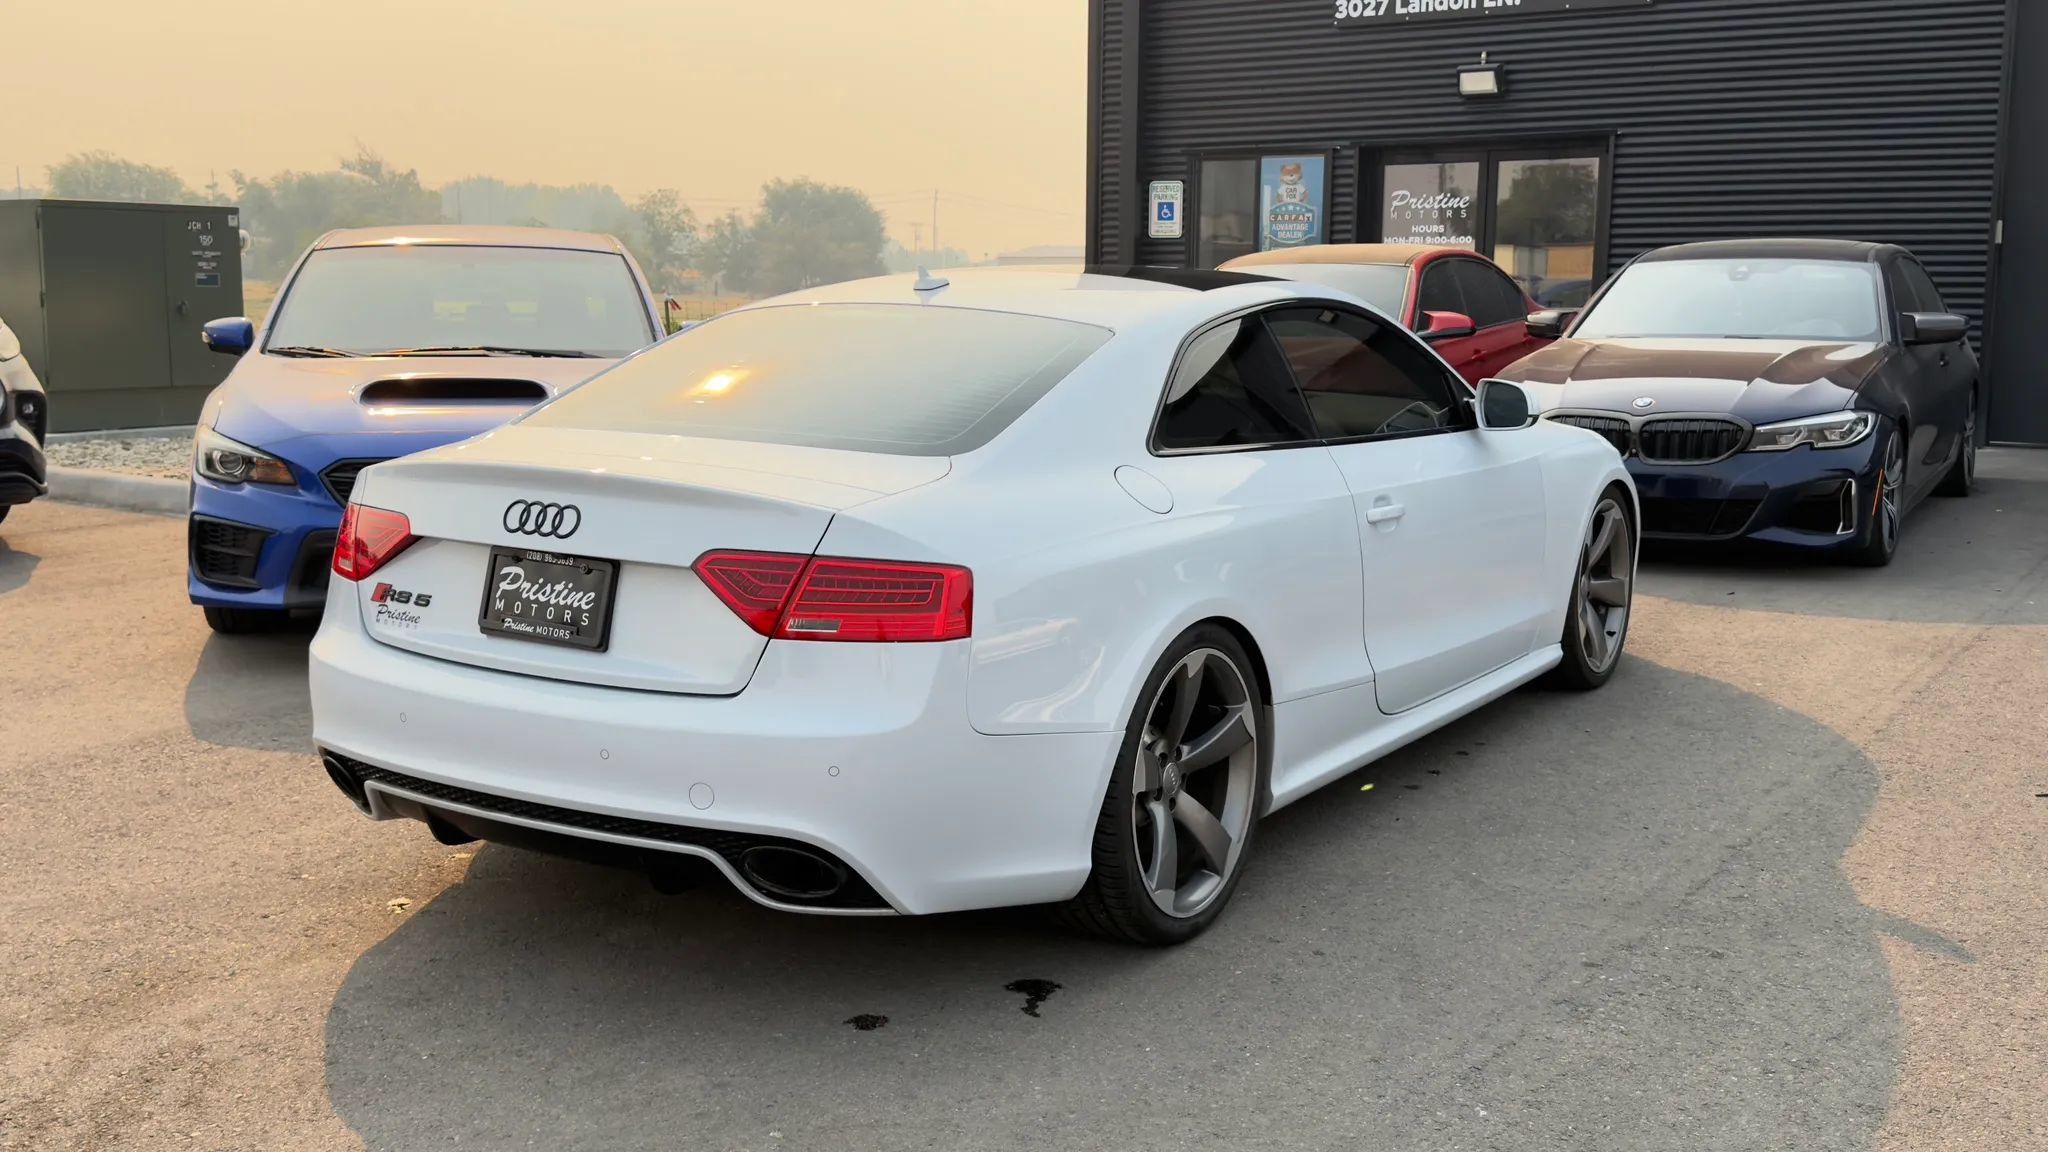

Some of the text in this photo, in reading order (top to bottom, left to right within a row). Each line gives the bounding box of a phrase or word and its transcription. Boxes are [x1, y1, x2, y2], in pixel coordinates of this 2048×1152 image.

[1334, 0, 1388, 19] 3027
[1391, 190, 1470, 212] Pristine
[1270, 213, 1312, 222] CARFAX
[1391, 209, 1467, 219] MOTORS
[1272, 223, 1309, 231] ADVANTAGE
[1411, 224, 1445, 233] HOURS
[1278, 231, 1302, 239] DEALER
[1384, 236, 1473, 244] MON-FRI 9:00-6:00
[526, 551, 543, 561] (208)
[496, 566, 596, 610] Pristine
[376, 603, 421, 624] Pristine
[495, 599, 590, 626] MOTORS
[504, 618, 570, 639] Pristine MOTORS
